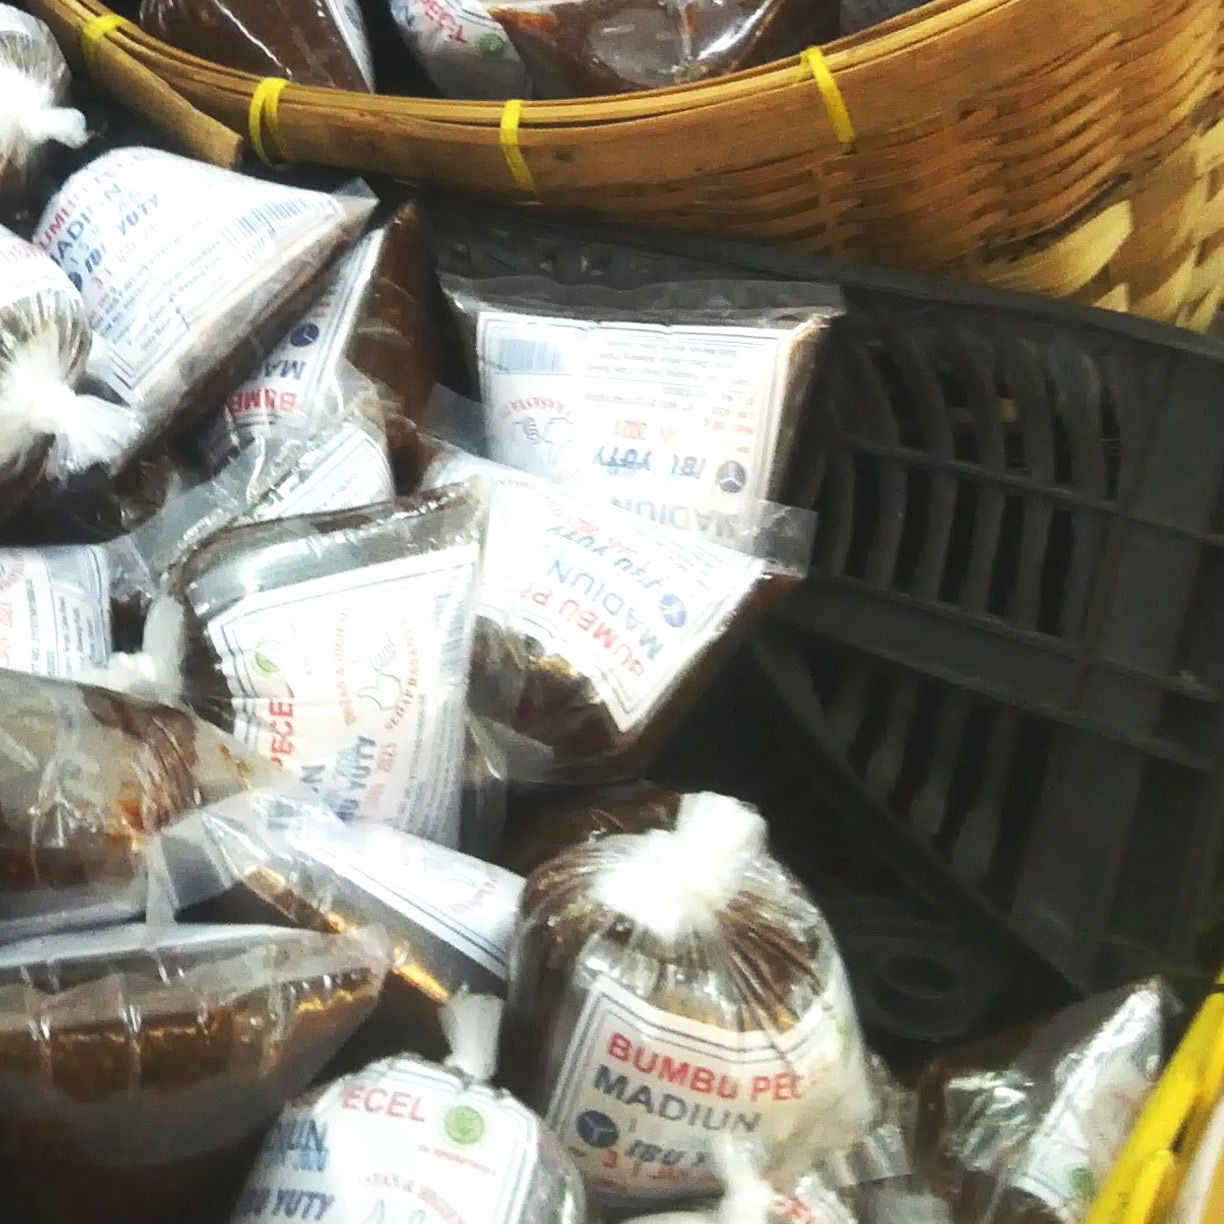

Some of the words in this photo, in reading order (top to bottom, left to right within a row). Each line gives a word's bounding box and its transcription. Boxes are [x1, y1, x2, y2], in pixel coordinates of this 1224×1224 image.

[115, 193, 156, 235] YUTY
[227, 386, 299, 414] BUMB
[544, 557, 662, 661] MADIUN
[556, 597, 646, 676] BUMBU
[593, 1064, 761, 1134] MADIUN
[605, 1031, 741, 1100] BUMBU
[750, 1071, 805, 1103] PEC
[341, 1082, 424, 1123] ECEL
